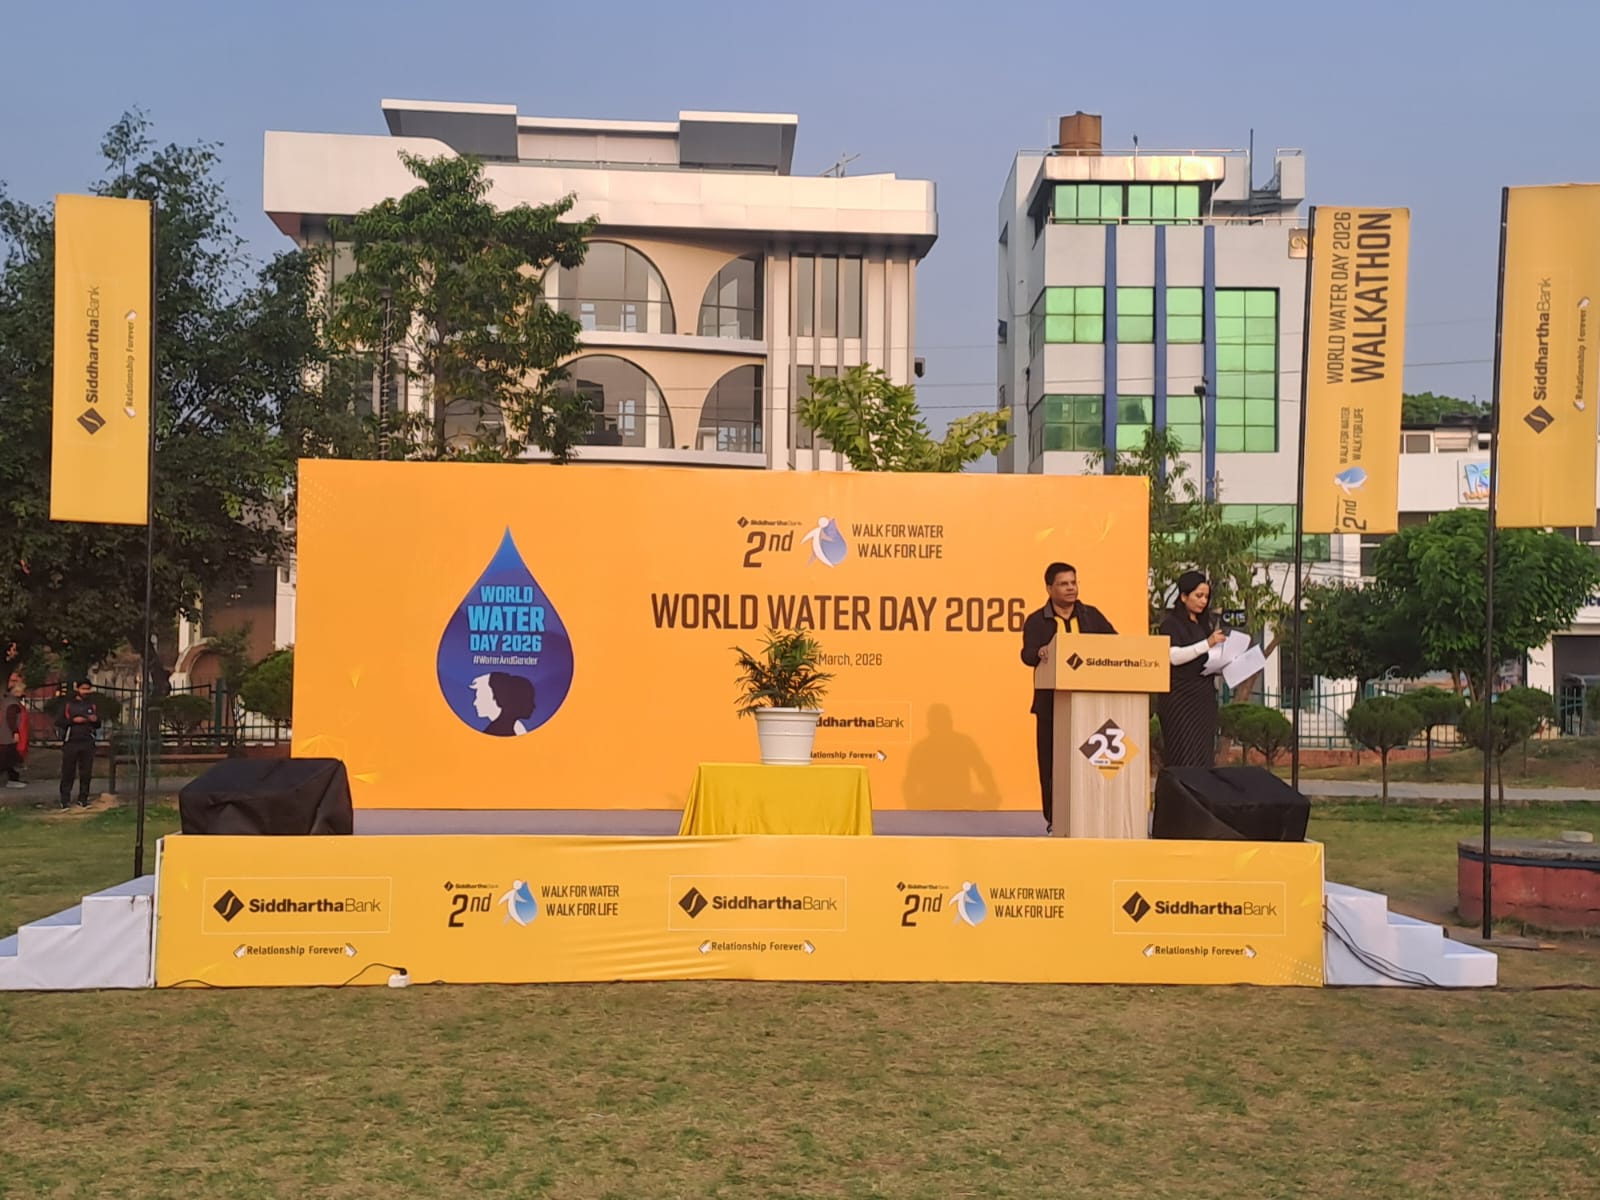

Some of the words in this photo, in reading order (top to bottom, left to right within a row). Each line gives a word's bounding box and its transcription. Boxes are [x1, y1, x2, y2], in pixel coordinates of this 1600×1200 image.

[1332, 211, 1352, 250] 2026
[1331, 253, 1350, 280] DAY
[1350, 213, 1392, 383] WALKATHON
[1329, 283, 1348, 332] WATER
[86, 286, 100, 403] SiddharthaBank
[125, 322, 135, 352] Forever
[1533, 277, 1551, 401] SiddharthaBank
[1326, 335, 1346, 384] WORLD
[126, 355, 136, 407] Relationship
[1575, 345, 1586, 400] Relationship
[1342, 499, 1367, 531] 2nd
[852, 523, 884, 538] WALK
[885, 524, 906, 538] FOR
[907, 524, 944, 538] WATER
[743, 530, 795, 568] 2nd
[857, 543, 893, 558] WALK
[894, 543, 917, 559] FOR
[918, 544, 943, 559] LIFE
[481, 586, 533, 603] WORLD
[468, 605, 545, 632] WATER
[651, 593, 759, 629] WORLD
[767, 594, 872, 631] WATER
[879, 596, 937, 632] DAY
[945, 597, 1025, 633] 2026
[470, 634, 499, 651] DAY
[502, 634, 542, 652] 2026
[818, 653, 853, 667] March,
[855, 653, 883, 666] 2026
[1086, 657, 1160, 668] SiddharthaBank
[815, 716, 904, 728] ddharthaBank
[1088, 728, 1126, 762] 23
[810, 751, 846, 760] lationship
[541, 885, 568, 898] WALK
[569, 885, 588, 898] FOR
[589, 885, 619, 897] WATER
[989, 888, 1016, 900] WALK
[1017, 888, 1035, 900] FOR
[1035, 888, 1066, 900] WATER
[249, 898, 381, 913] SiddharthaBank
[448, 893, 492, 928] 2nd
[546, 903, 575, 917] WALK
[577, 903, 597, 916] FOR
[598, 903, 618, 916] LIFE
[712, 896, 837, 911] SiddharthaBank
[901, 893, 943, 927] 2nd
[994, 905, 1023, 918] WALK
[1024, 905, 1044, 918] FOR
[1044, 905, 1064, 918] LIFE
[1155, 901, 1277, 916] SiddharthaBank
[246, 945, 305, 956] Relationship
[309, 946, 343, 955] Forever
[711, 941, 767, 952] Relationship
[770, 942, 803, 951] Forever
[1155, 945, 1208, 956] Relationship
[1212, 946, 1244, 955] Forever
